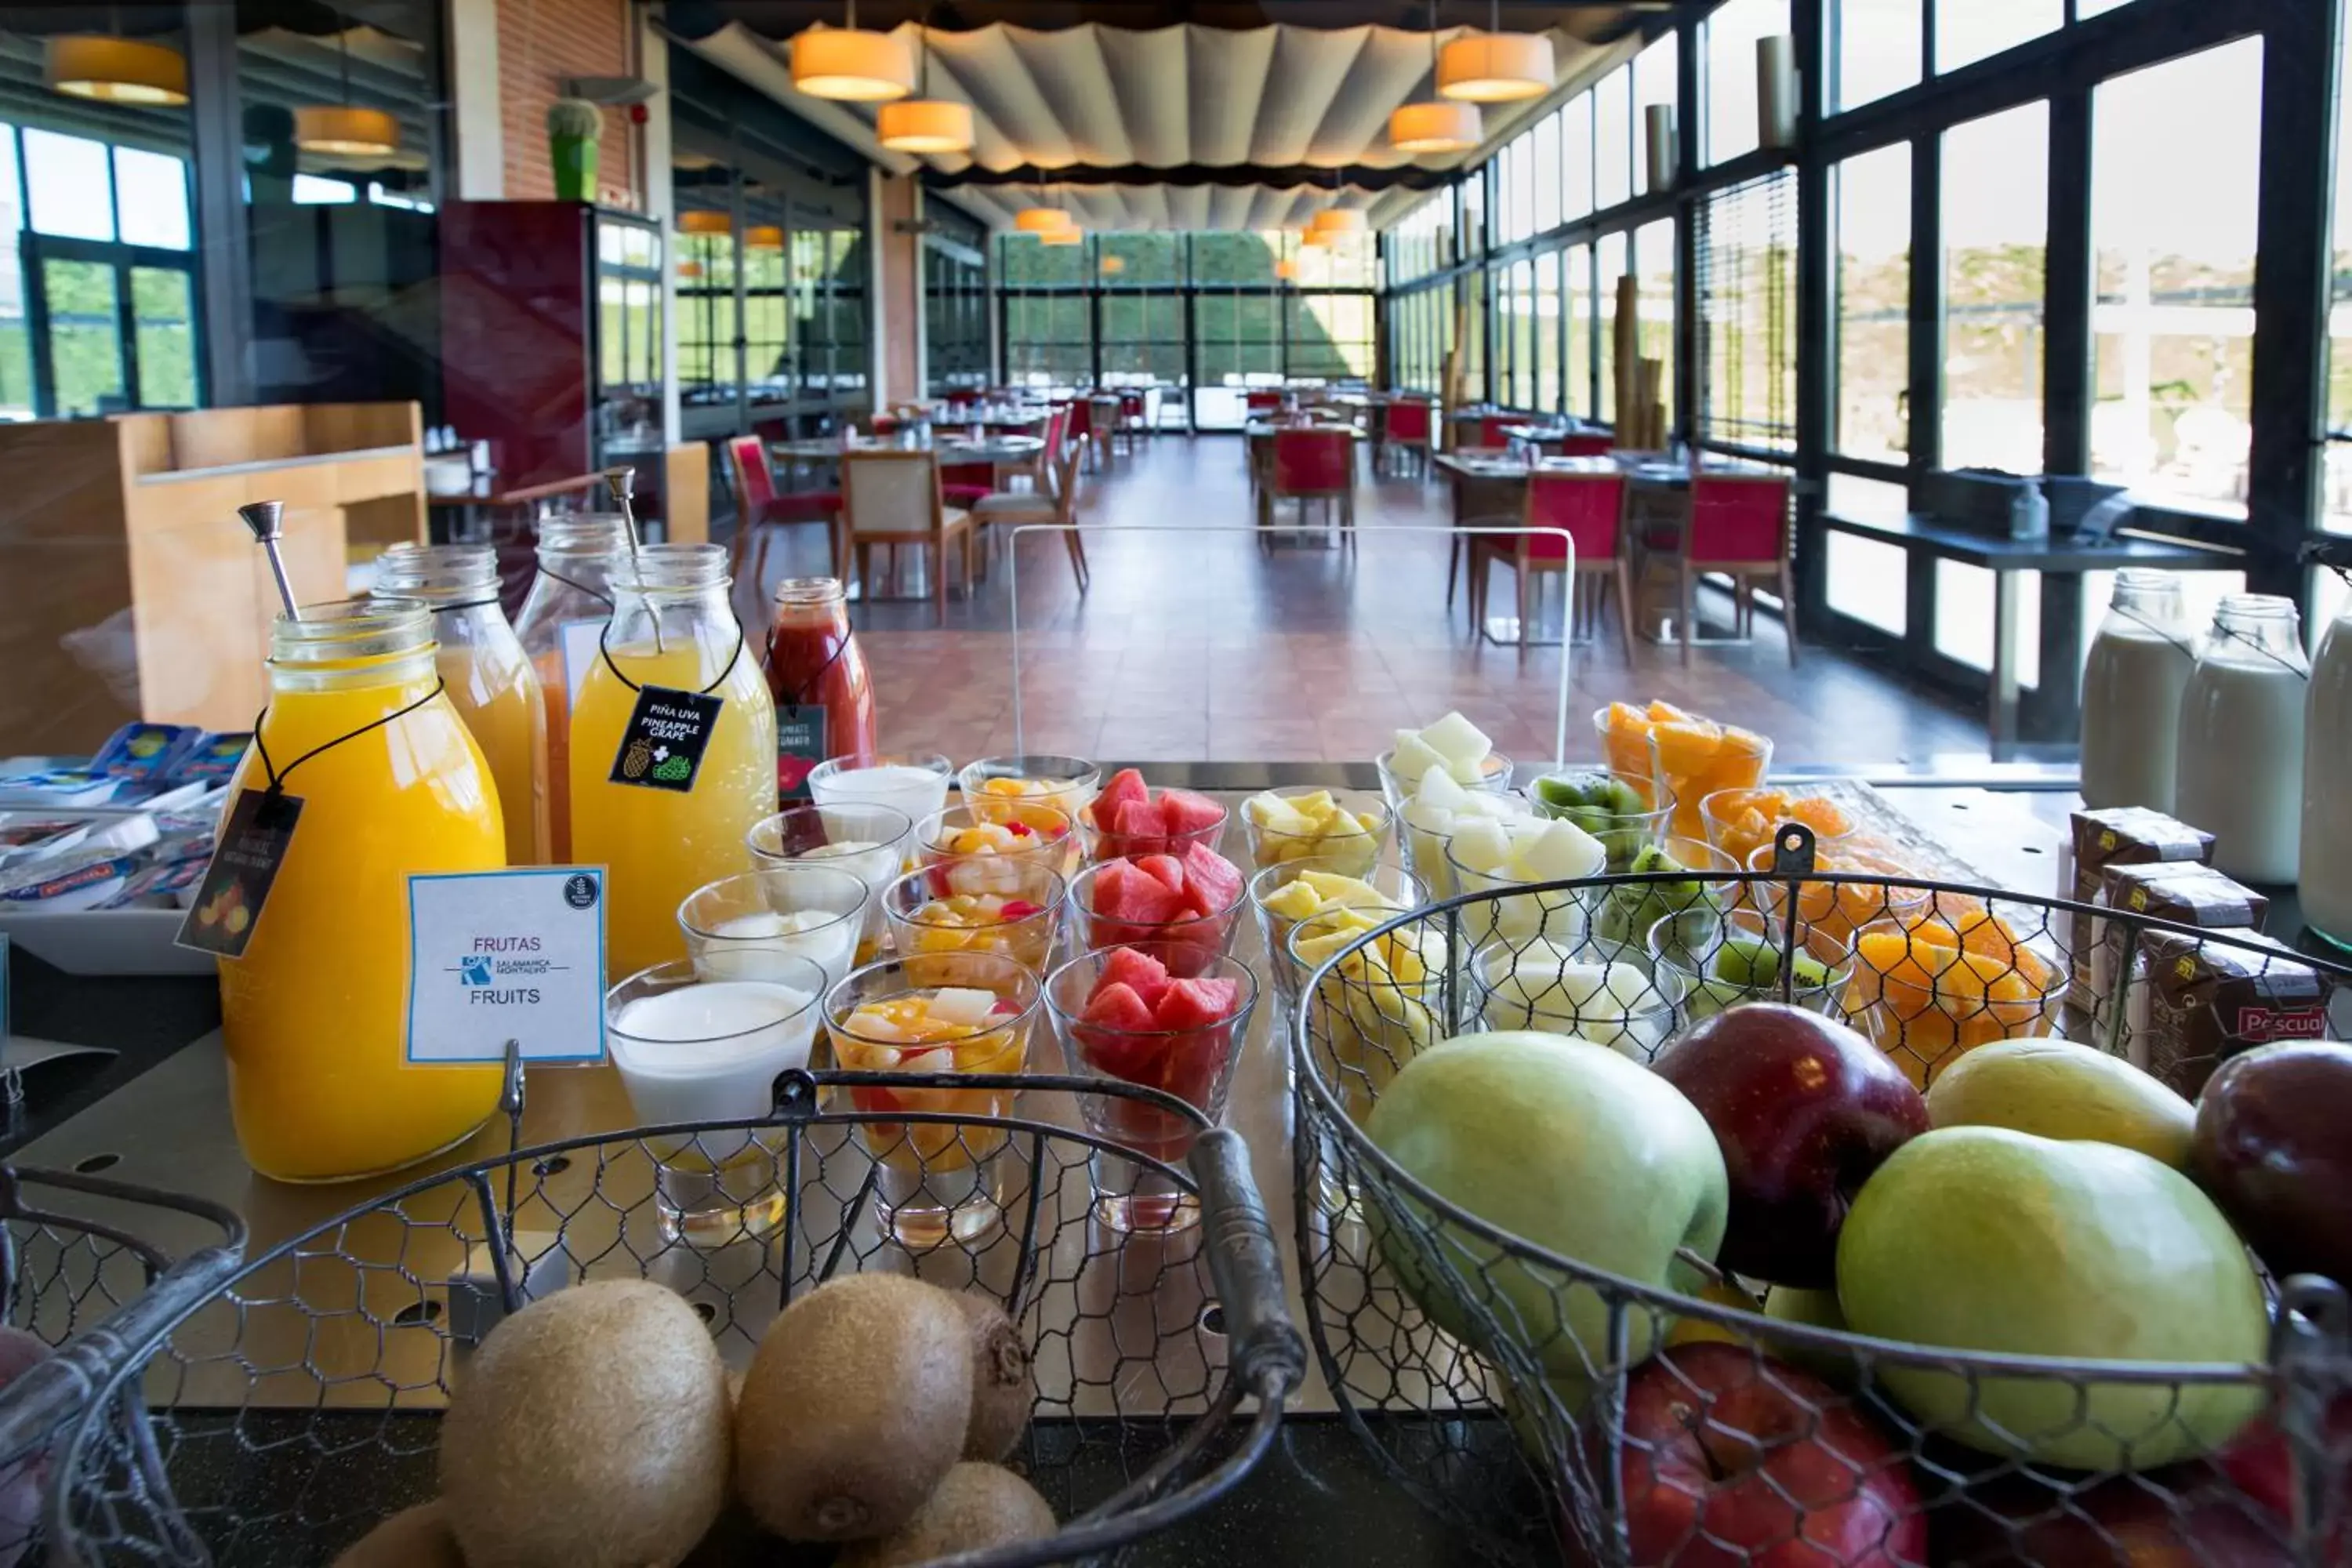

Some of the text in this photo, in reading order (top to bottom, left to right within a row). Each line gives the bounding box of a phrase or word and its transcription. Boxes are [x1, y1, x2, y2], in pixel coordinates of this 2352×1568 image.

[650, 703, 701, 721] PIÑA UVA
[641, 717, 700, 735] PINEAPPLE
[649, 728, 686, 741] GRAPE
[474, 936, 541, 953] FRUTAS
[470, 989, 541, 1004] FRUITS
